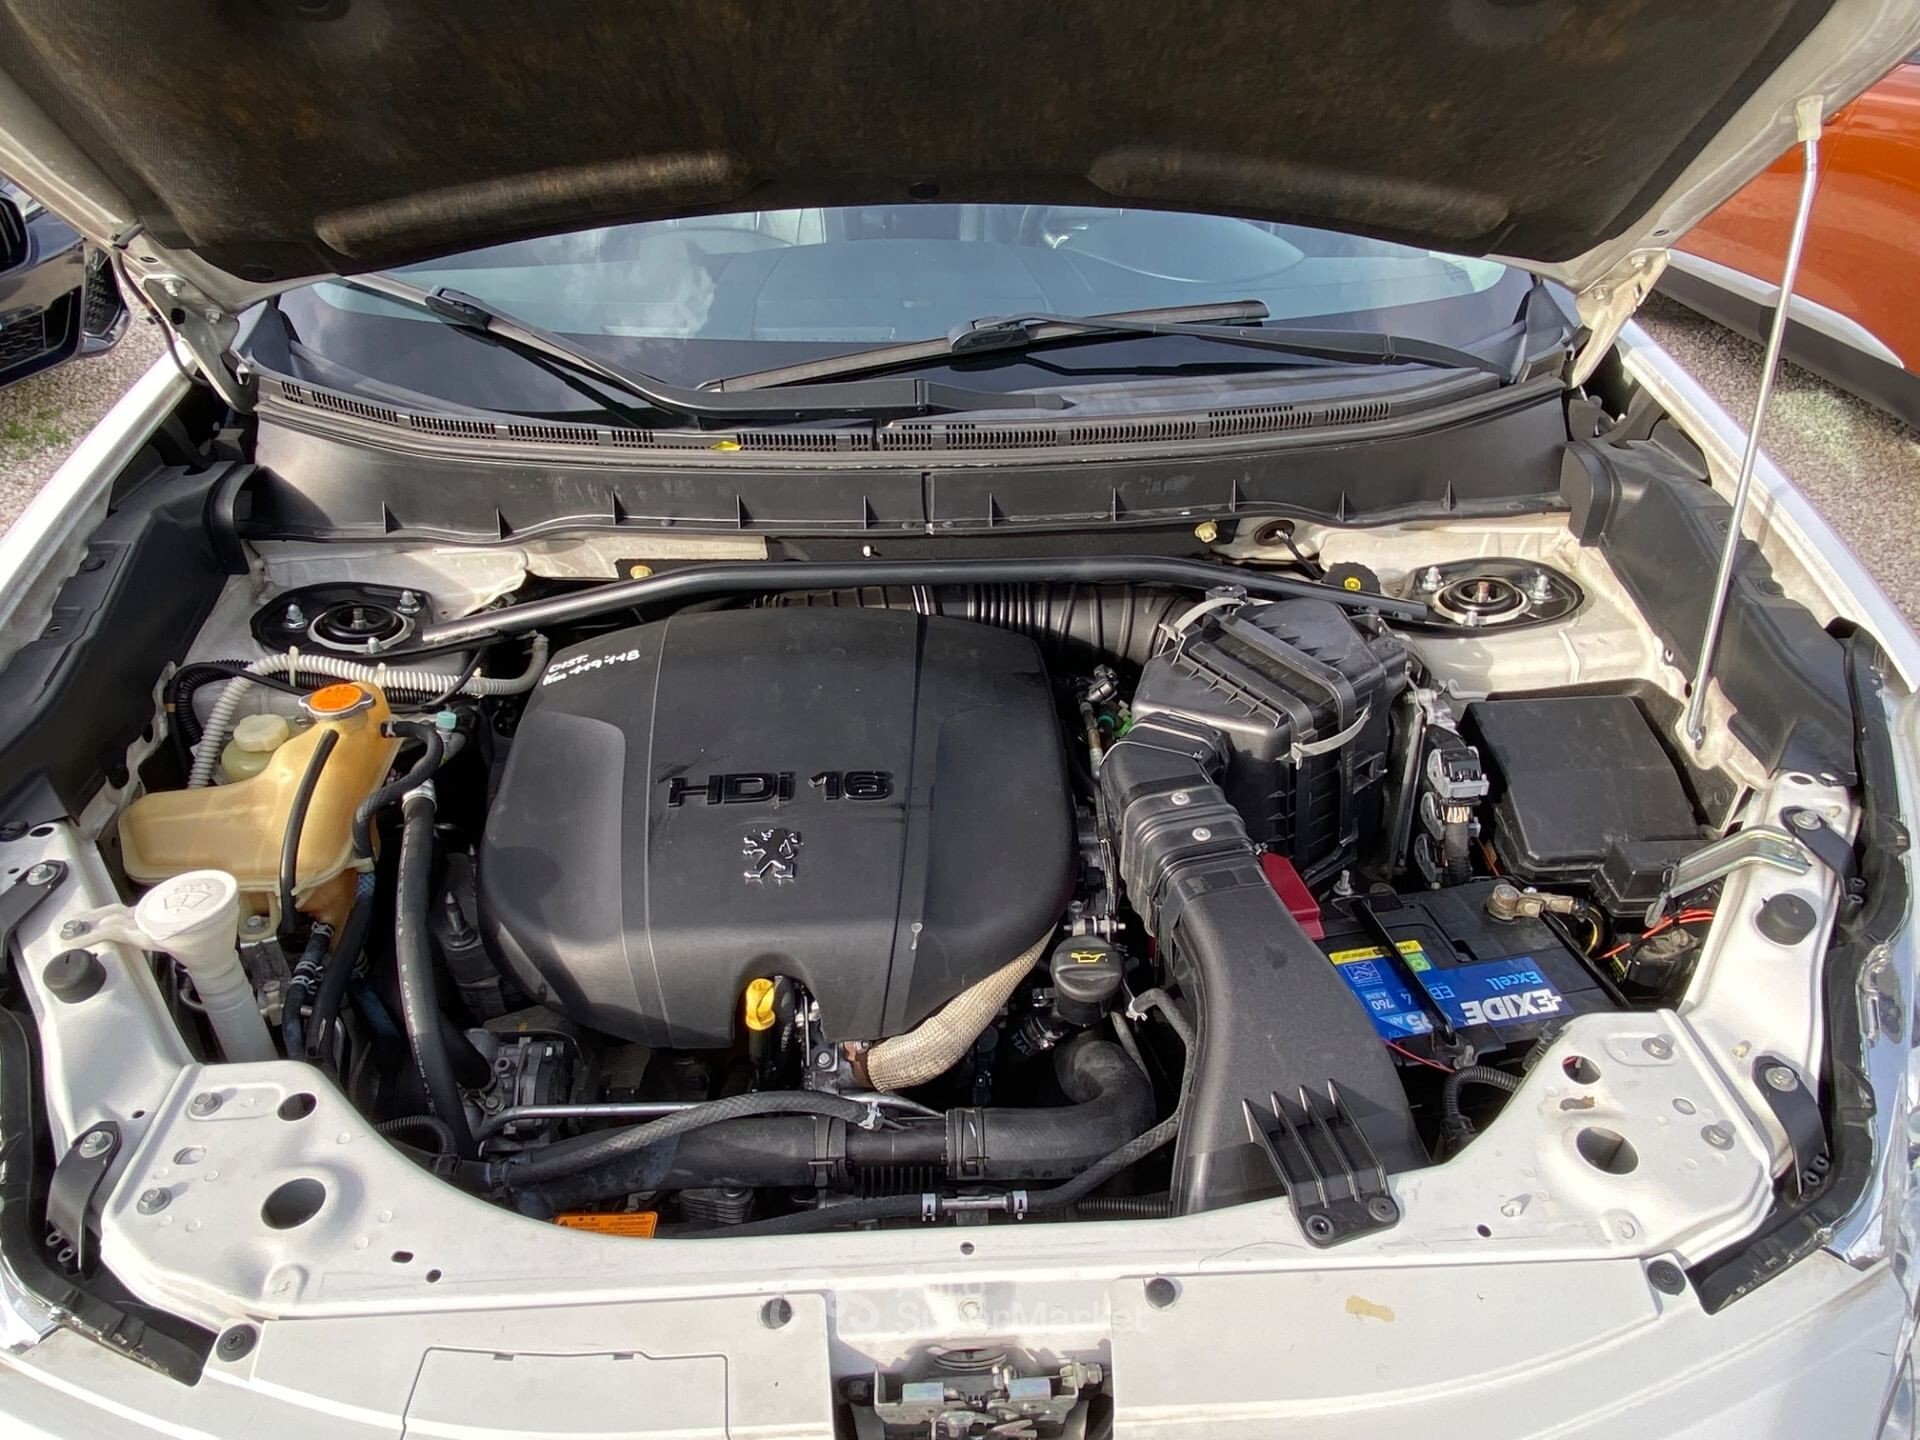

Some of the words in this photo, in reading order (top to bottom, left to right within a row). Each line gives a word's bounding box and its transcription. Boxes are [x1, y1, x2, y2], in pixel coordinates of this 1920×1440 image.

[667, 771, 796, 808] HDi
[808, 770, 893, 802] 16
[1485, 970, 1543, 991] Excell
[1371, 998, 1396, 1011] 760
[1460, 988, 1562, 1026] EXIDE
